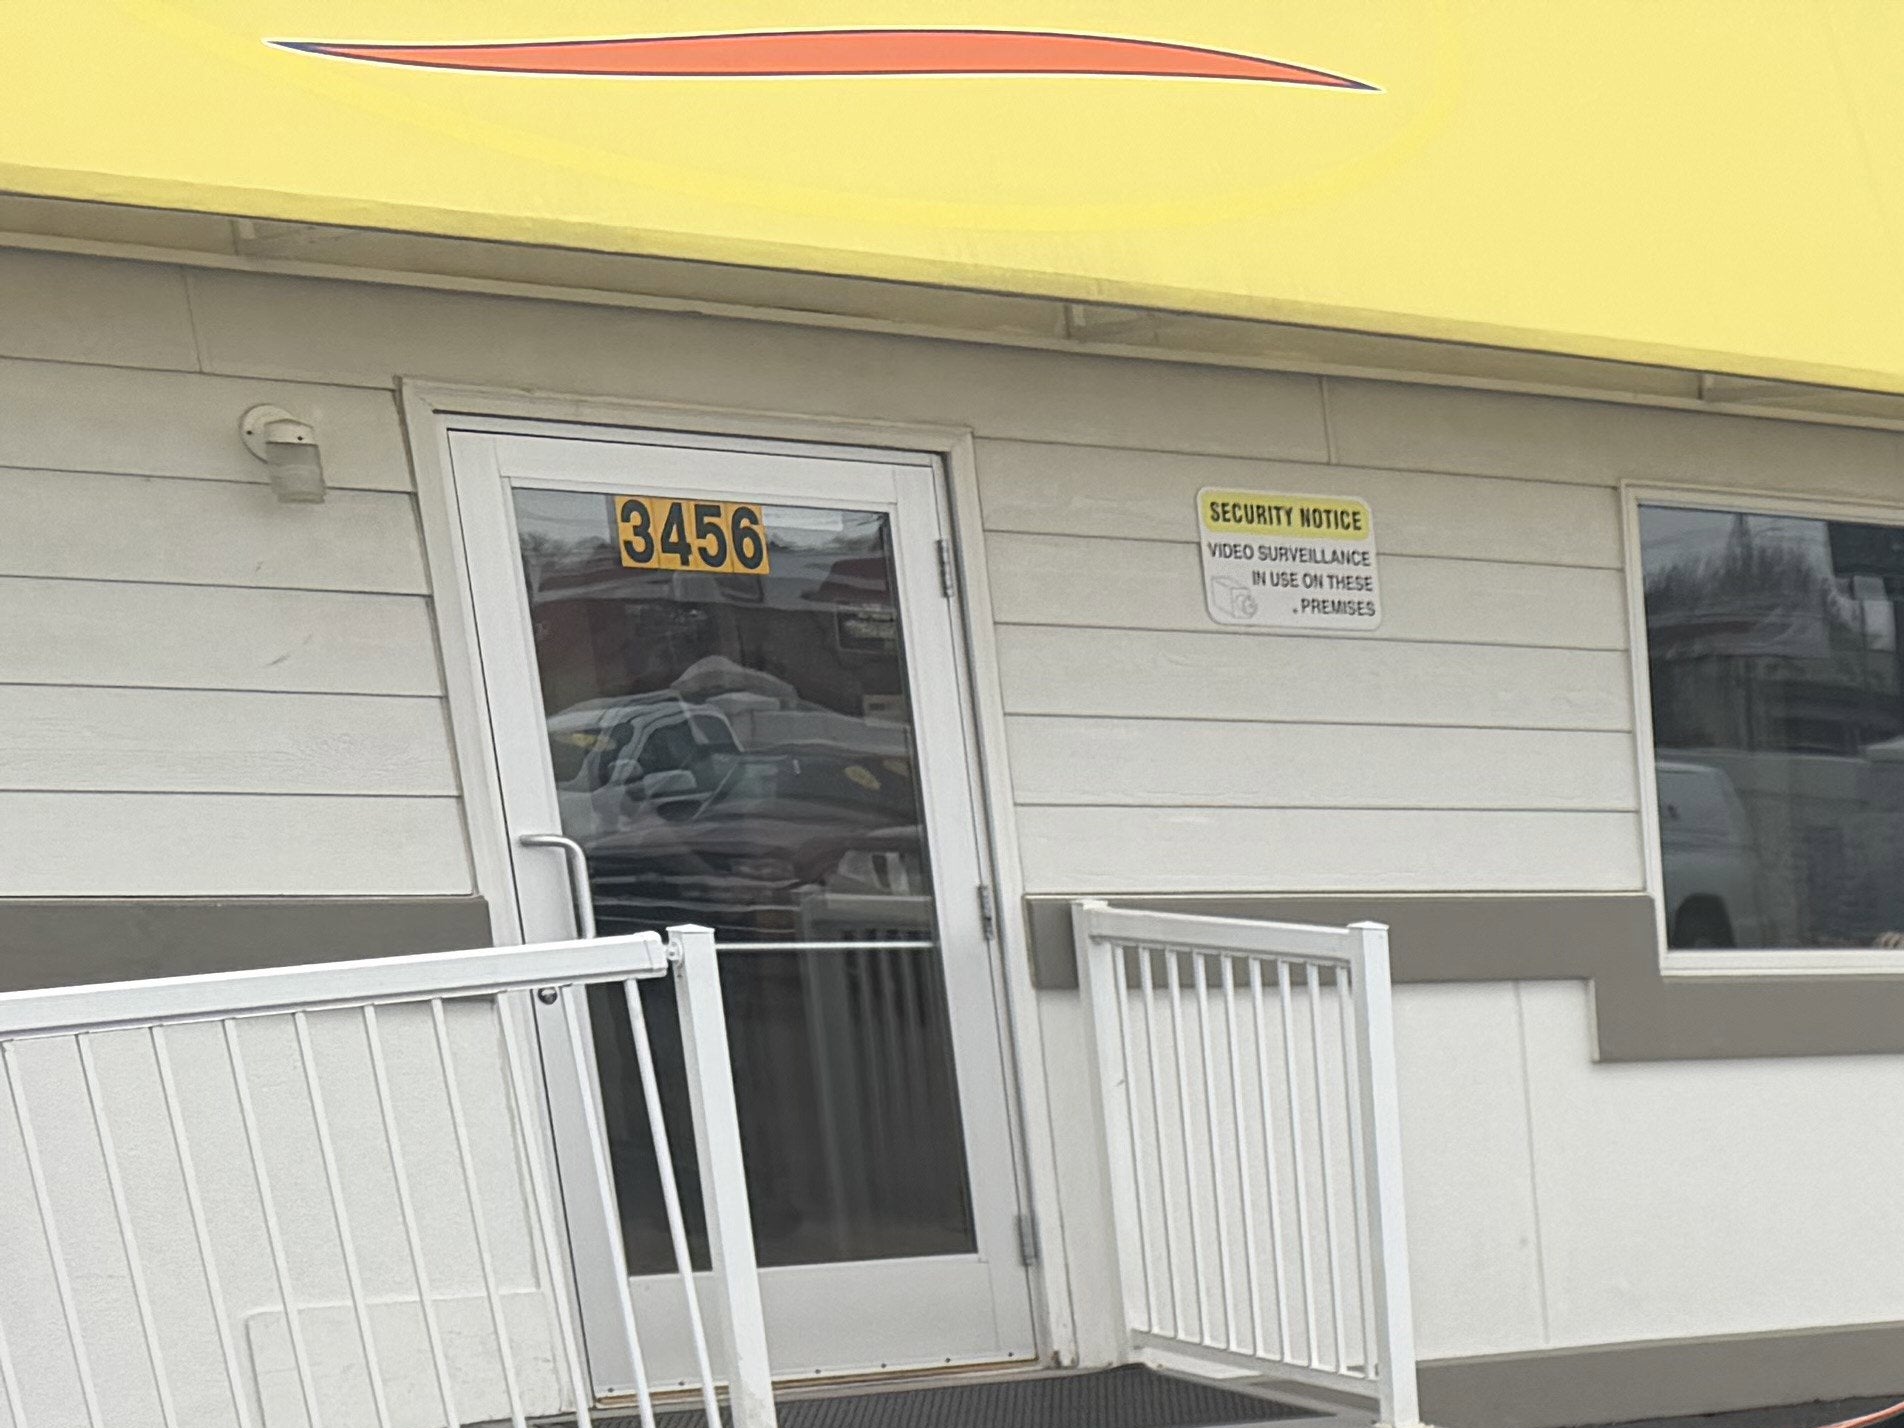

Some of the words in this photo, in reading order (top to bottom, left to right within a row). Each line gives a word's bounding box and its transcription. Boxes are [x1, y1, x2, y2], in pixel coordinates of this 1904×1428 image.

[1209, 501, 1293, 527] SECURITY
[1300, 507, 1362, 531] NOTICE
[620, 499, 764, 570] 3456
[1207, 541, 1254, 560] VIDEO
[1258, 545, 1372, 567] SURVEILLANCE
[1251, 570, 1266, 586] IN
[1270, 571, 1299, 588] USE
[1302, 572, 1323, 589] ON
[1327, 574, 1373, 592] THESE
[1300, 598, 1376, 617] PREMISES
